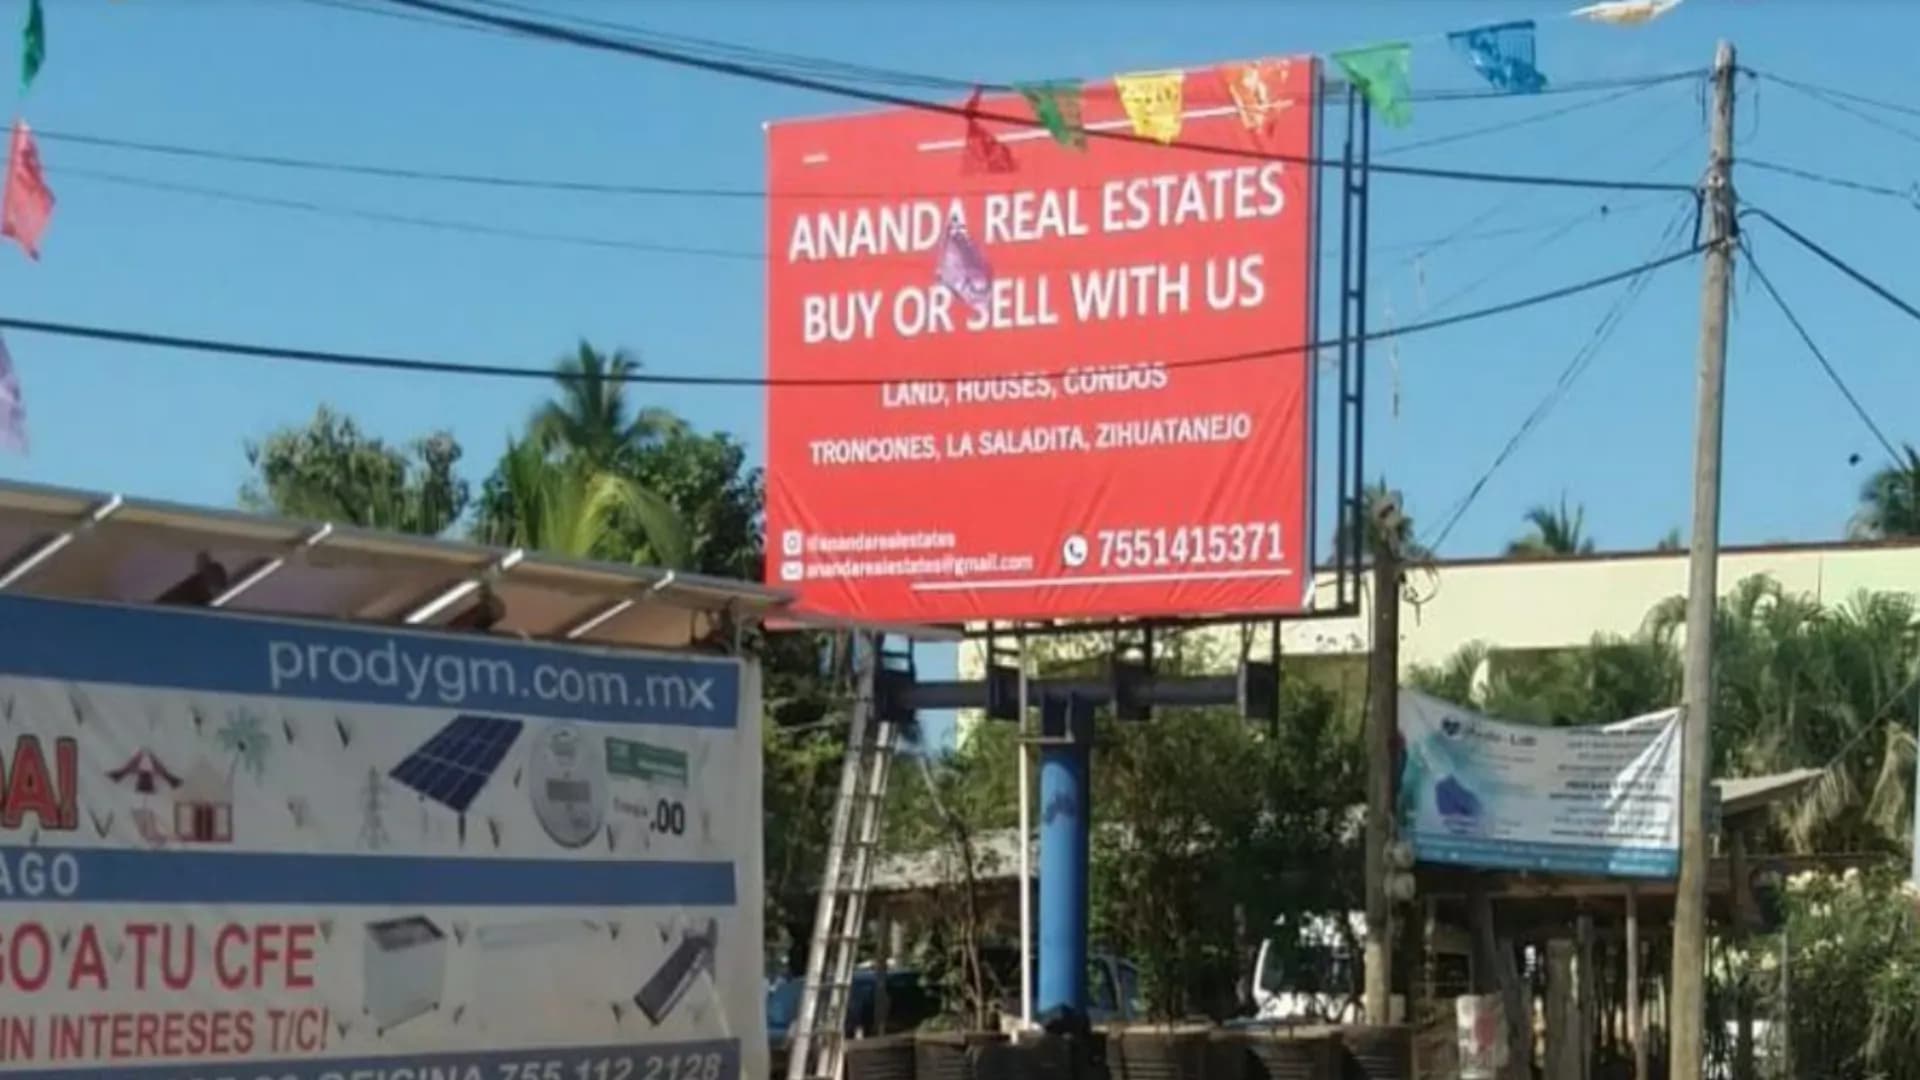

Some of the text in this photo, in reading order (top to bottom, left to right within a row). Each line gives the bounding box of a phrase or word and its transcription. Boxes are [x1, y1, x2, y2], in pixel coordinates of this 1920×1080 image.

[787, 164, 1286, 263] ANANDA REAL ESTATES
[803, 255, 1267, 344] BUY OR SELL WITH US
[882, 361, 1169, 408] LAND, HOUSES, CONDOS
[809, 413, 1251, 465] TRONCONES, LA SALADITA, ZIHUATANEJO
[1098, 522, 1283, 568] 7551415371
[268, 640, 715, 712] prodygm.com.mx
[0, 922, 315, 993] O A TU CFE
[49, 1008, 256, 1058] INTERESES
[498, 1061, 564, 1080] 755
[574, 1058, 632, 1080] 112
[643, 1053, 723, 1080] 2128
